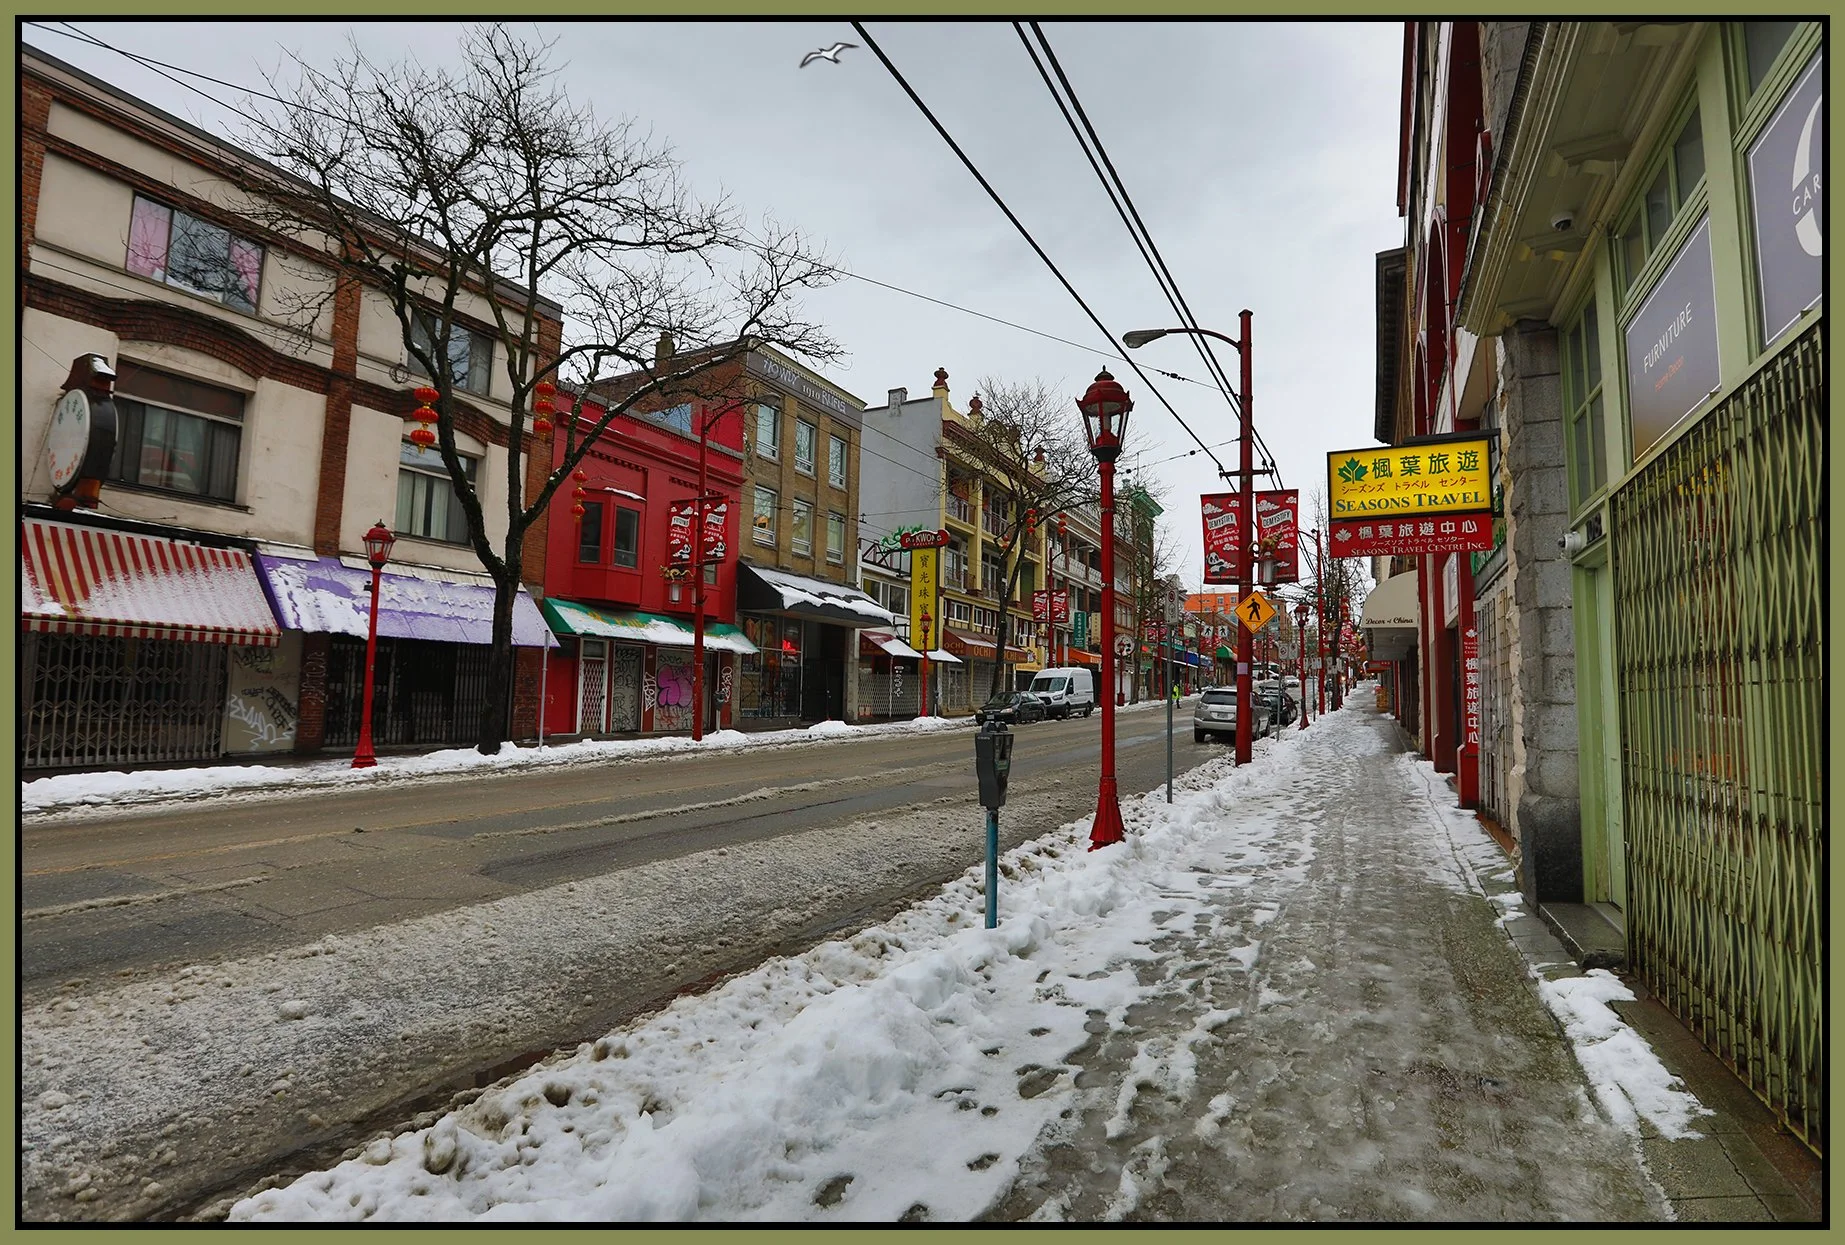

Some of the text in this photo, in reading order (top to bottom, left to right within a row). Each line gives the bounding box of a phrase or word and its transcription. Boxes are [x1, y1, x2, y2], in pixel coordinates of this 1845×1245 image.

[1643, 302, 1692, 374] FURNITURE
[802, 385, 821, 400] 1910
[1371, 450, 1480, 480] 楓葉旅遊
[1341, 476, 1478, 495] シーズンズ トラベル センター
[1335, 491, 1485, 513] SEASONS TRAVEL
[1358, 519, 1478, 540] 楓葉旅遊中心
[1351, 541, 1487, 556] SEASONS TRAVEL CENTRE INC.
